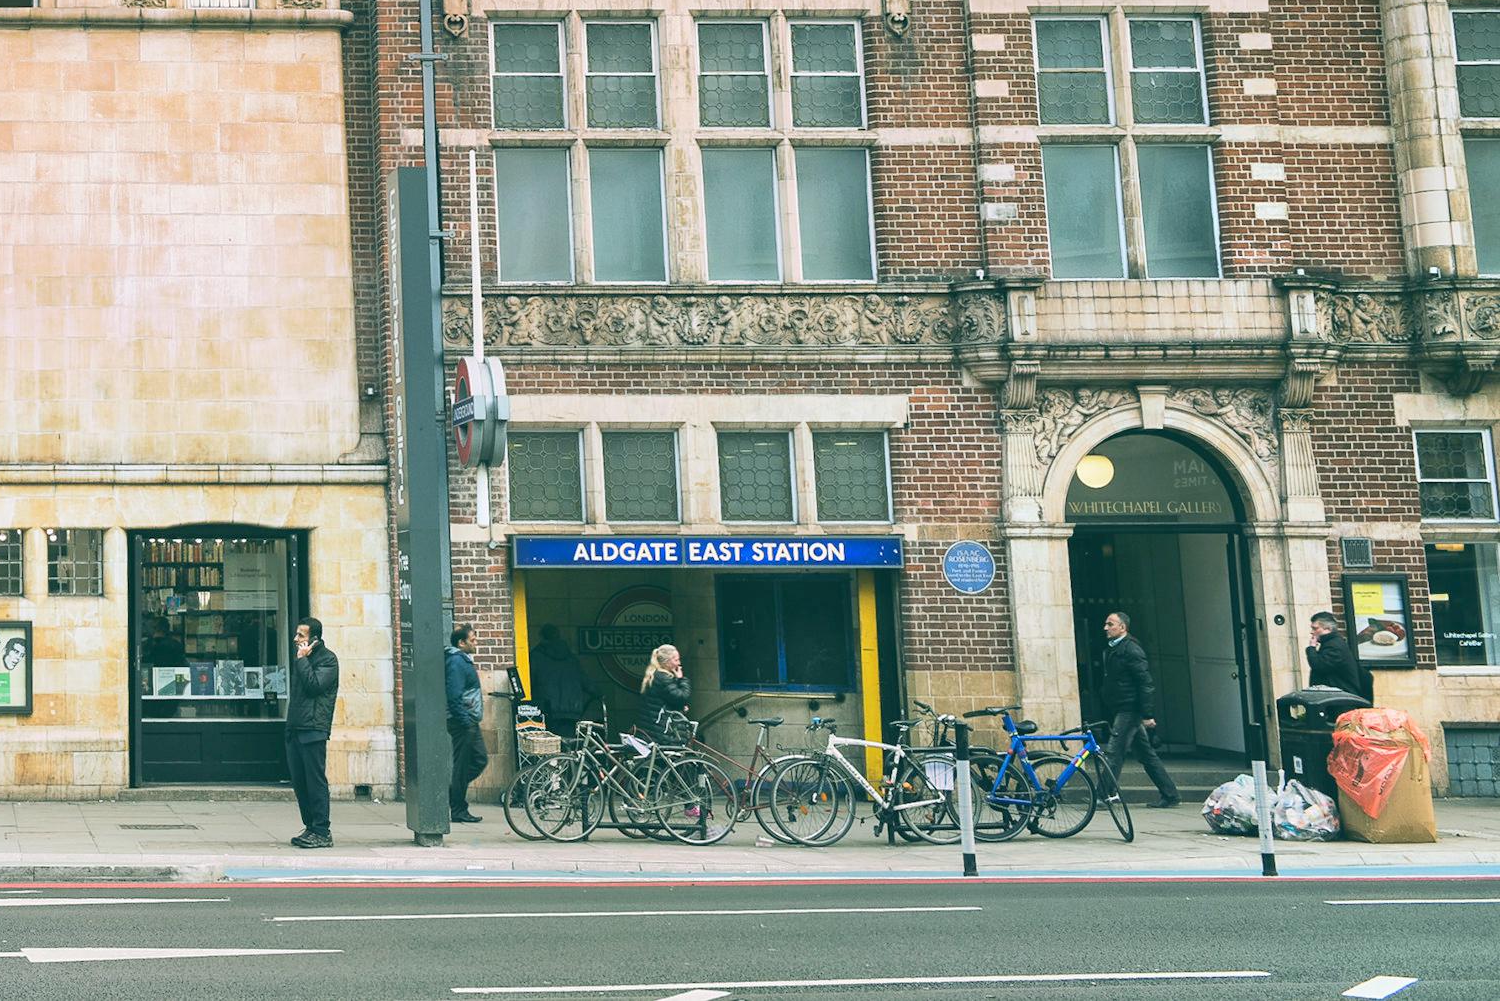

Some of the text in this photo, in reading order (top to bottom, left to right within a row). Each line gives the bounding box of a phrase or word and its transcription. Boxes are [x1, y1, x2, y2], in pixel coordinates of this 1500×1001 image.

[389, 187, 405, 506] Whitechapel Gallery
[1068, 501, 1163, 514] WHITECHAPEL
[573, 542, 846, 562] ALDGATE EAST STATION
[624, 613, 669, 623] LONDON
